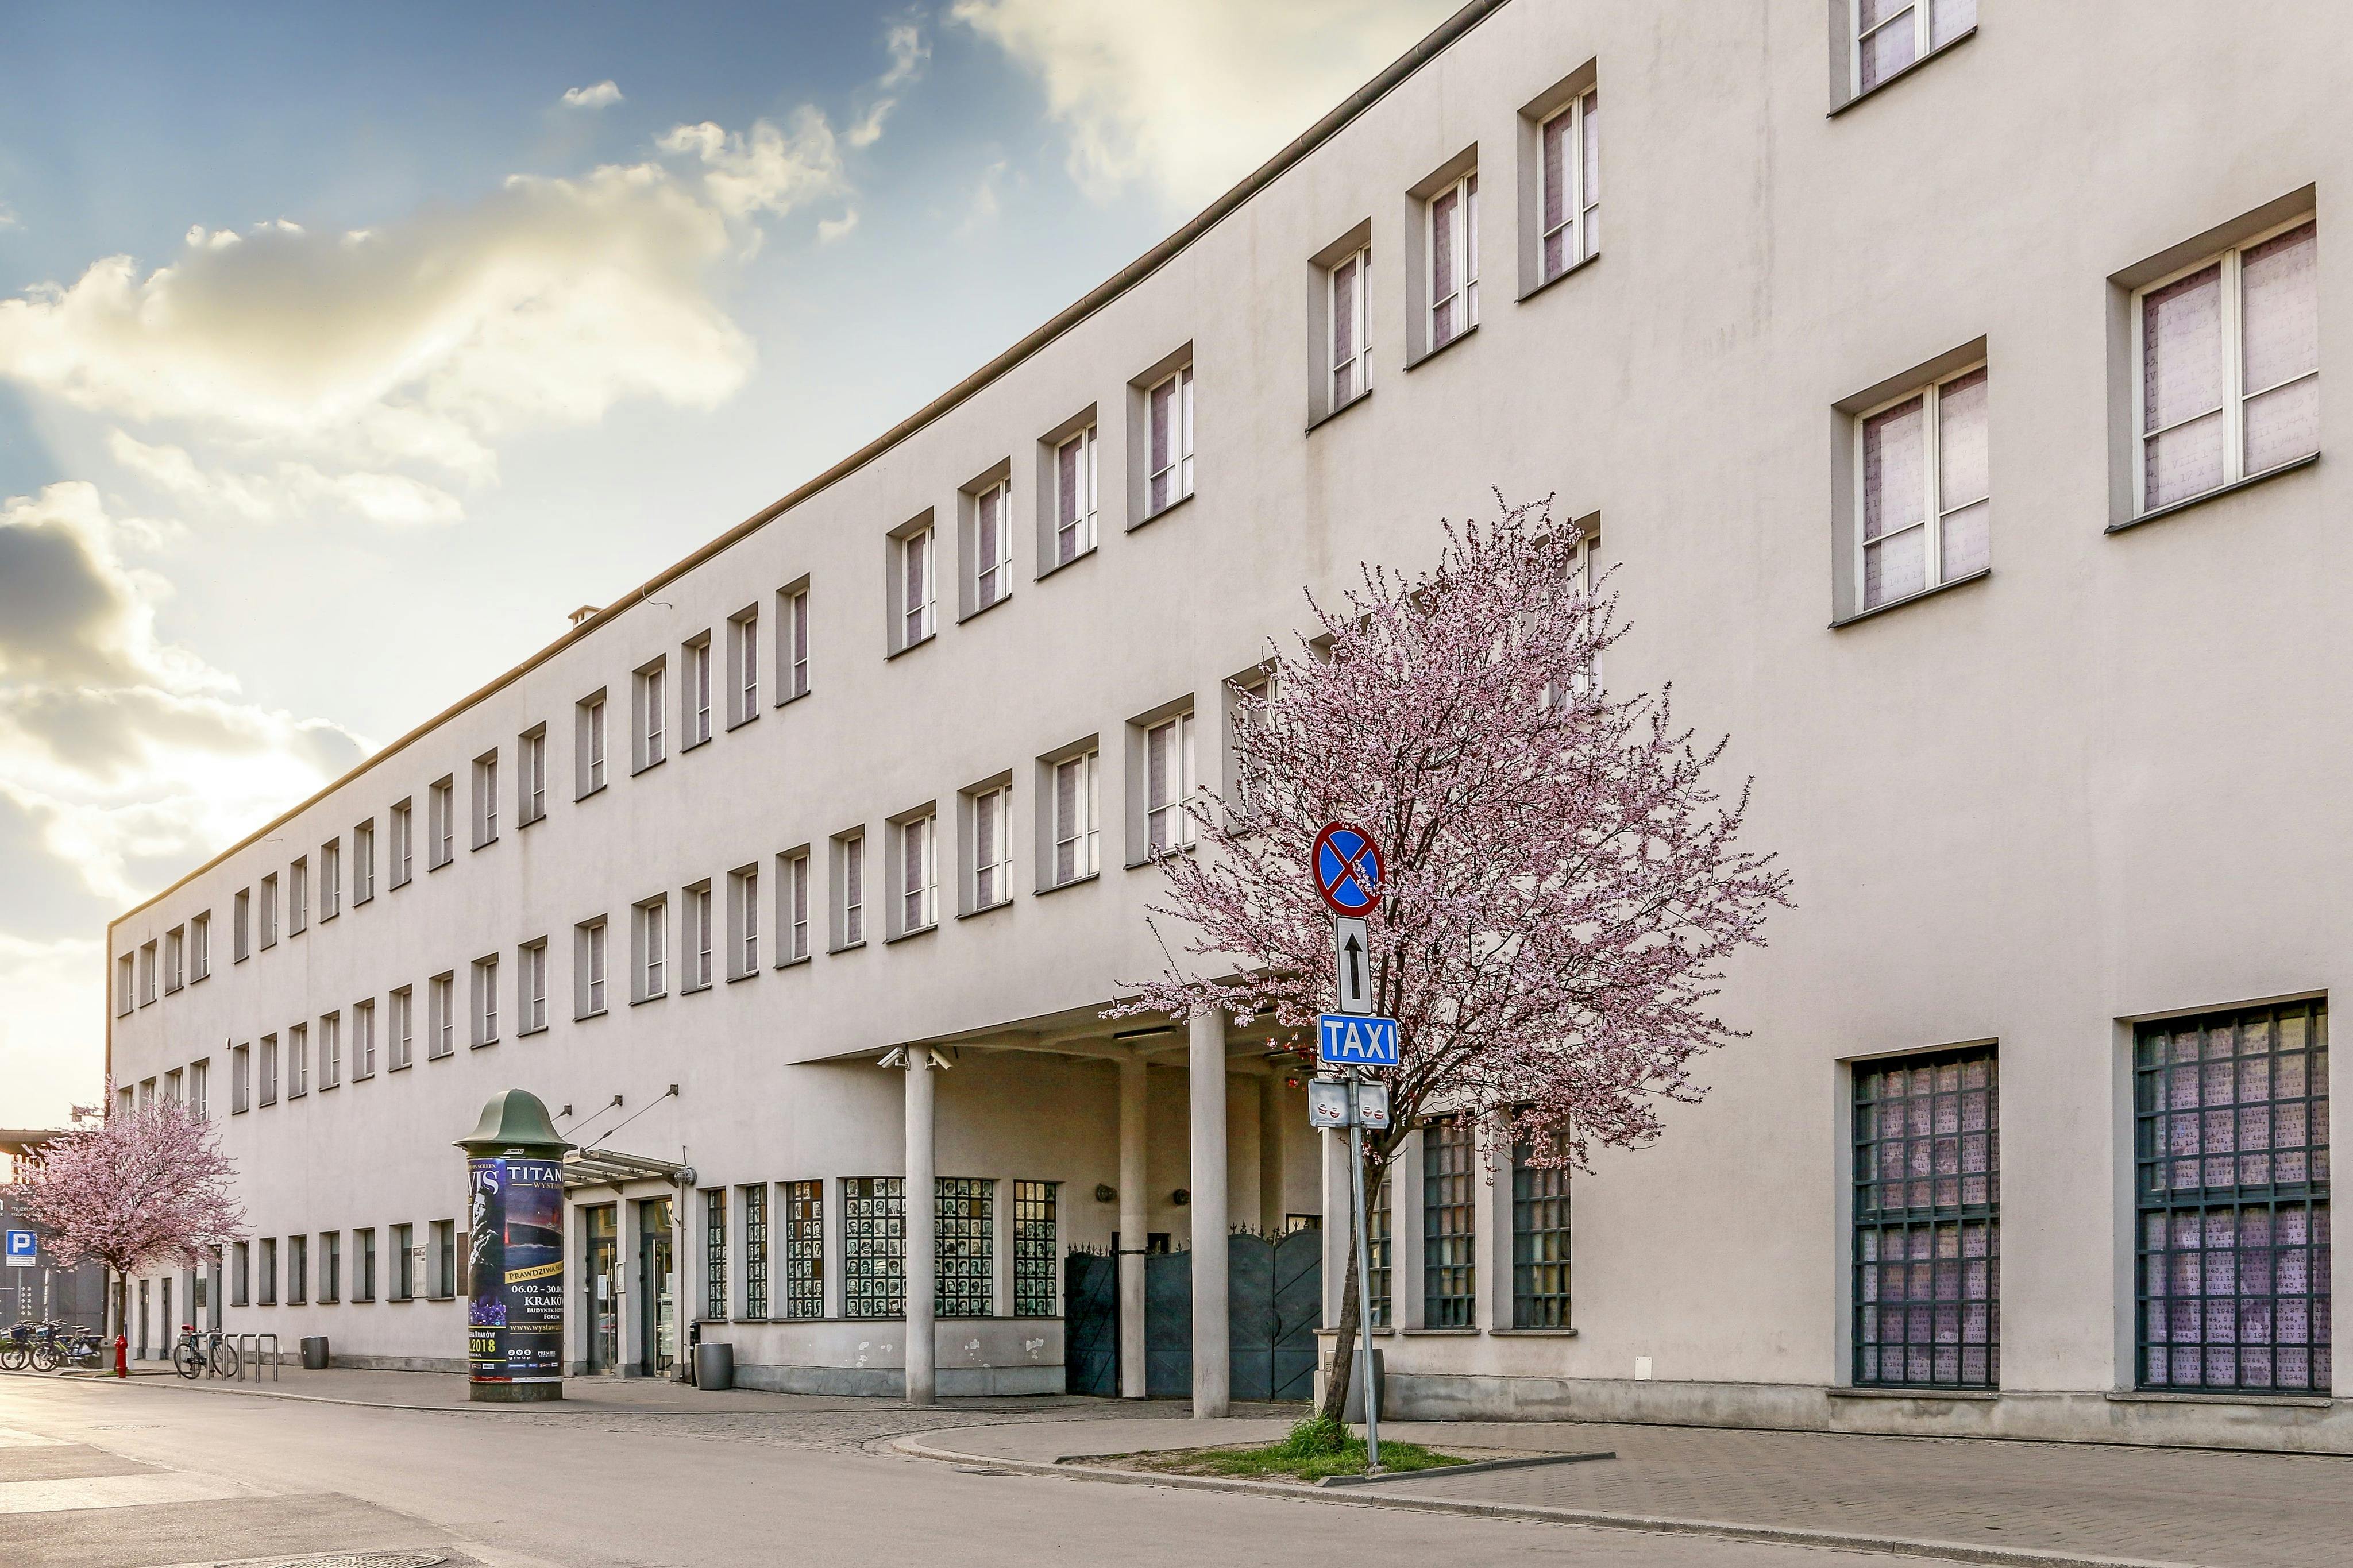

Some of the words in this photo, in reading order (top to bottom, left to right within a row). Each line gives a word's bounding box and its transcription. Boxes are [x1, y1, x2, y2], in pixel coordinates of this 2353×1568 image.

[1324, 1020, 1395, 1059] TAXI
[13, 1233, 30, 1253] P
[509, 1266, 556, 1280] PRAWDZIWA
[511, 1285, 538, 1293] 06.02
